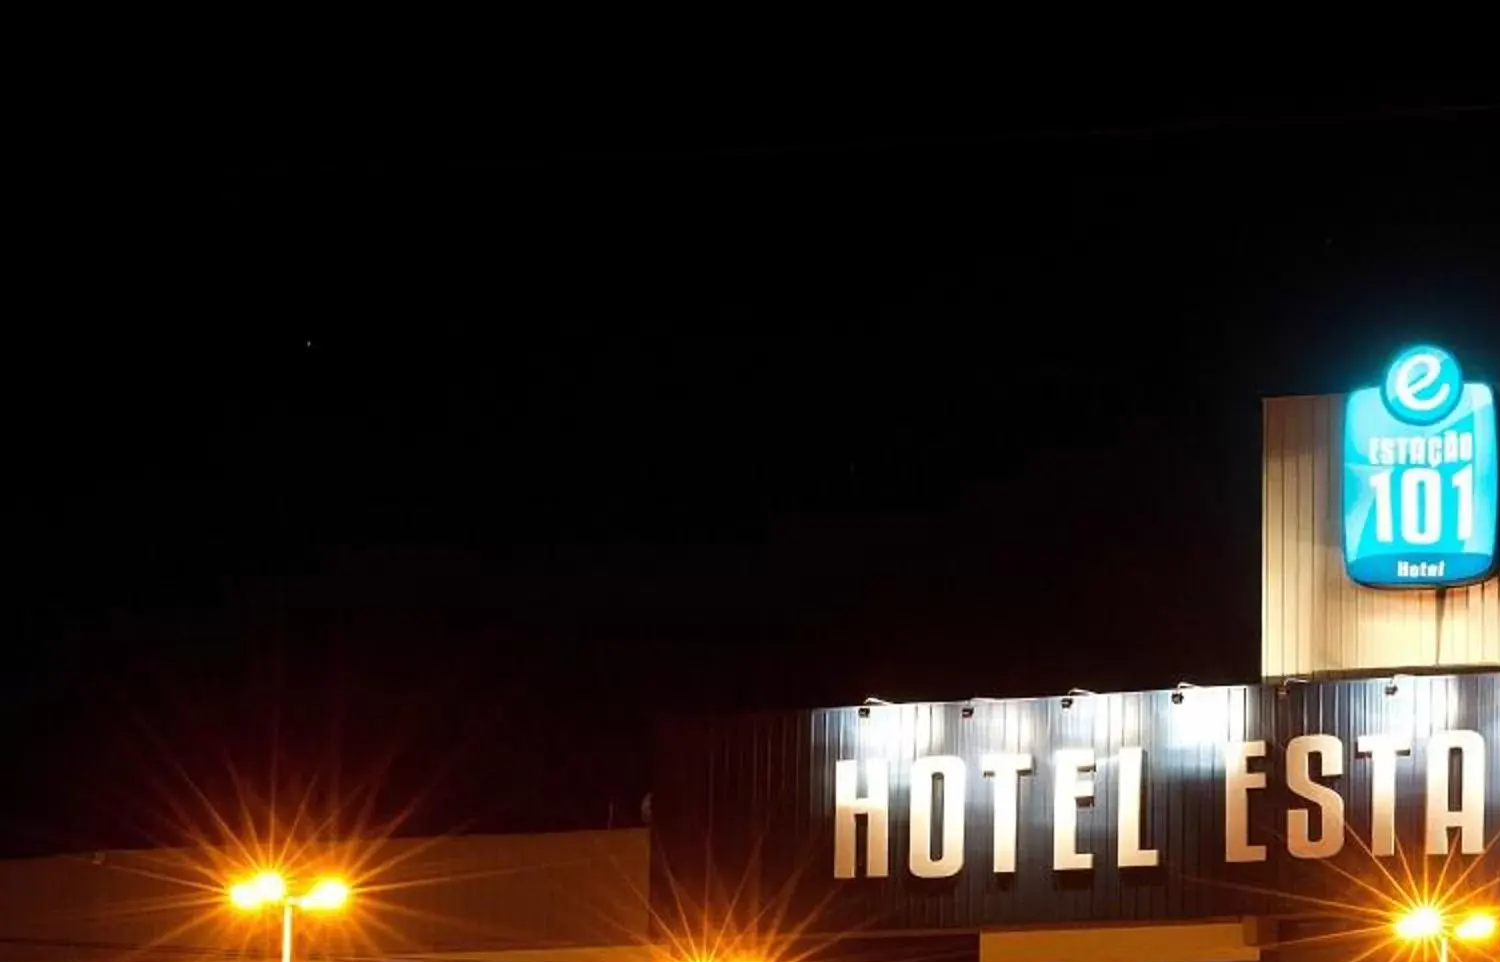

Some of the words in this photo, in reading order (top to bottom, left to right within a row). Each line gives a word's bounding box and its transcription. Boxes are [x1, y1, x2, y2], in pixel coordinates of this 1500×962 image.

[1396, 354, 1450, 411] e
[1368, 430, 1473, 467] ESTAÇÃO
[1369, 463, 1473, 545] 101
[834, 747, 1160, 879] HOTEL
